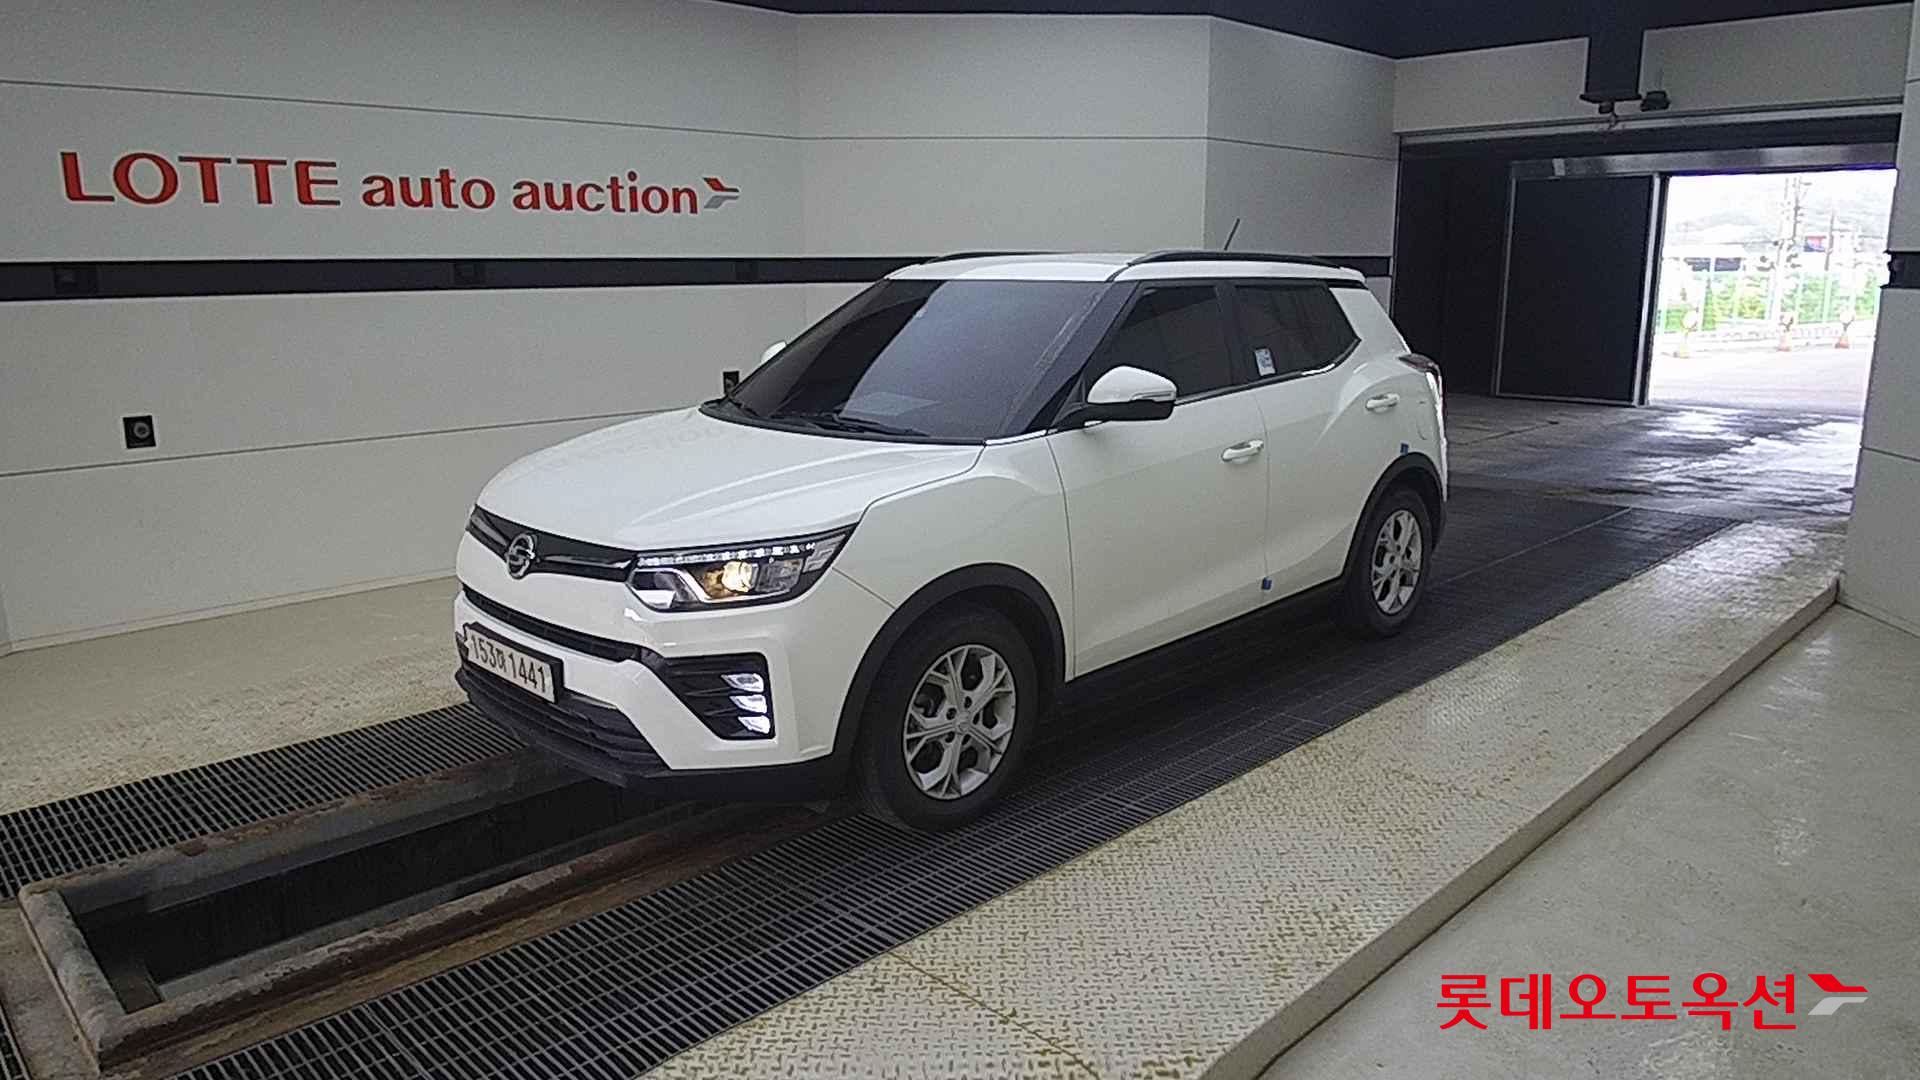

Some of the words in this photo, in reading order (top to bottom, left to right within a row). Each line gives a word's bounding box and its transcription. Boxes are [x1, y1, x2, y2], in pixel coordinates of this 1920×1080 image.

[60, 151, 341, 206] LOTTE
[361, 168, 497, 210] auto
[512, 170, 699, 215] auction
